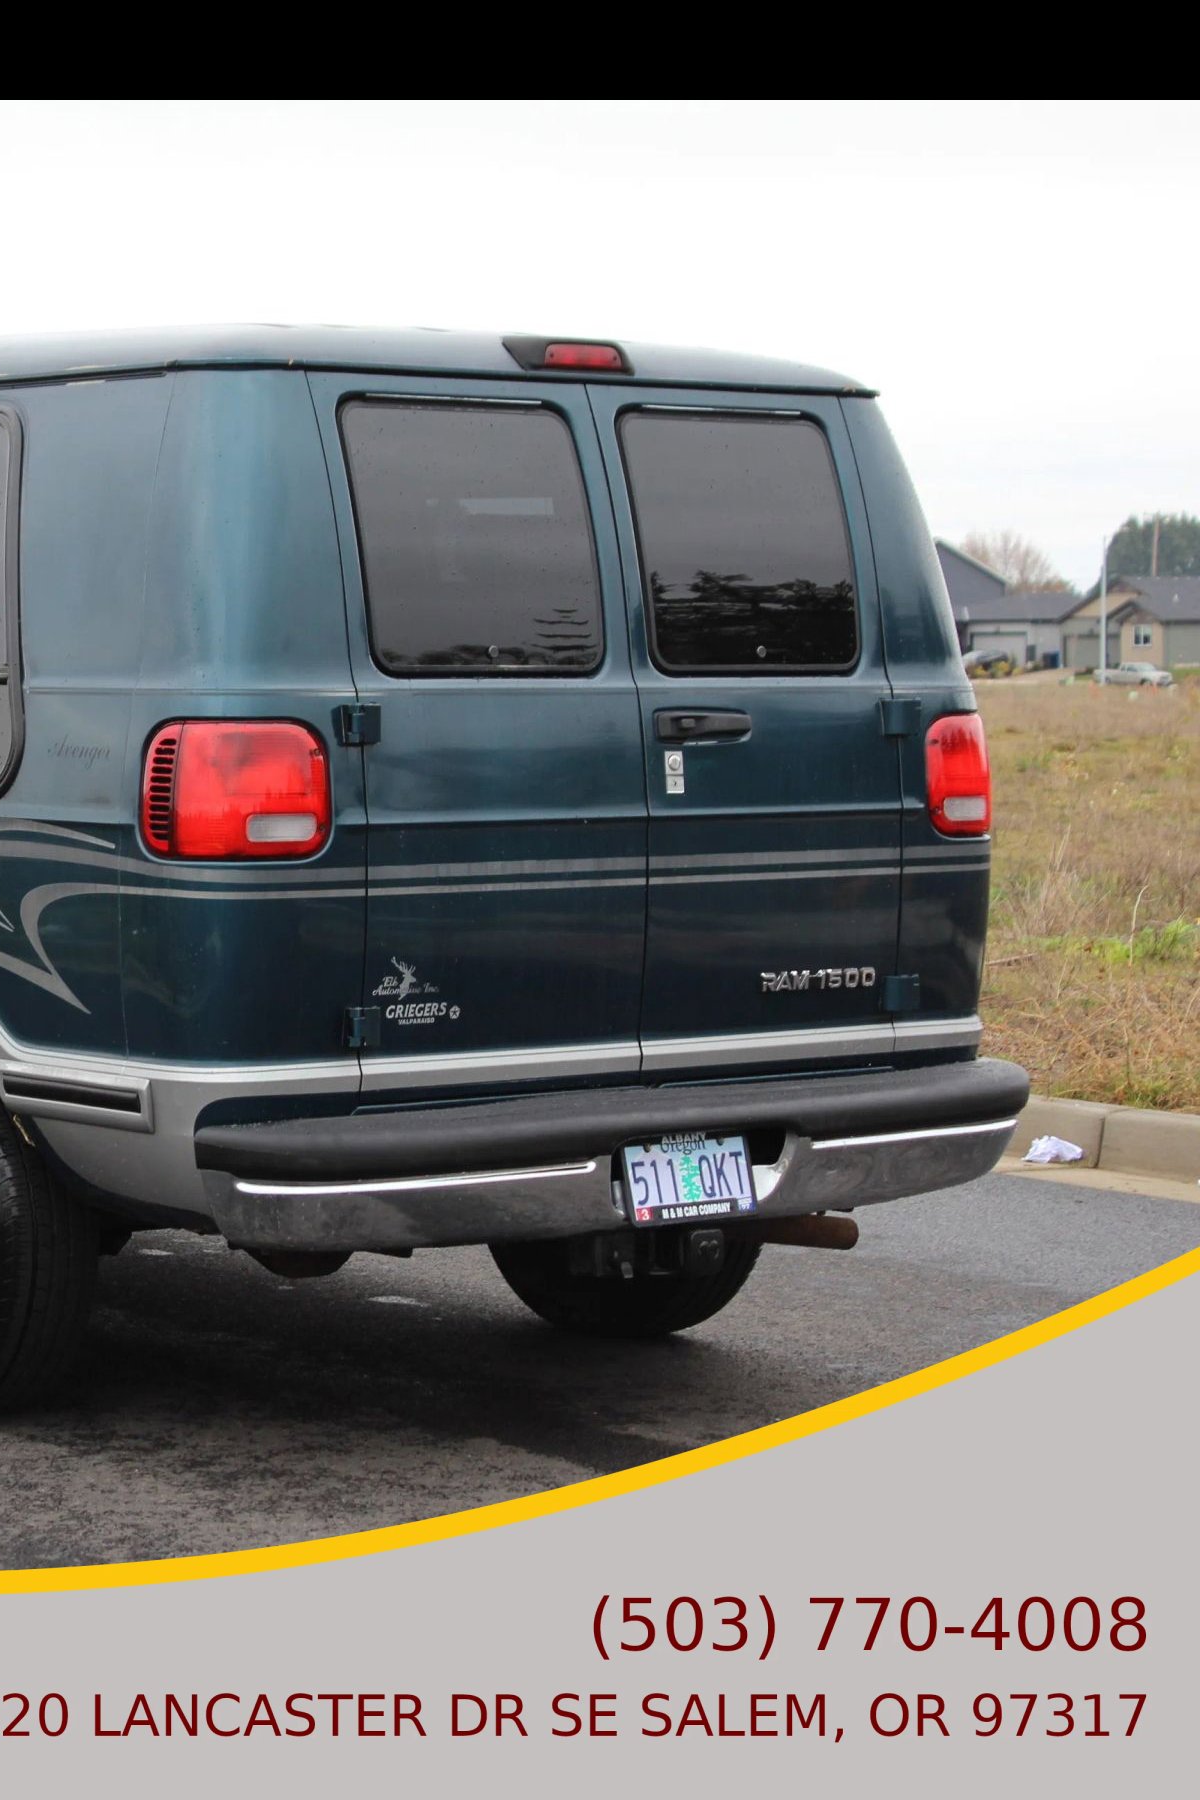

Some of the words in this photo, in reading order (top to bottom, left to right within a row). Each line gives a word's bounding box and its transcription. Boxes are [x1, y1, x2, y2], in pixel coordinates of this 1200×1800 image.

[372, 984, 421, 996] Automive
[385, 1002, 448, 1019] GRIEGERS
[398, 1017, 436, 1026] VALPARAISO
[661, 1131, 706, 1144] ALBANY
[660, 1139, 706, 1155] Oregon
[631, 1158, 680, 1206] 511
[698, 1151, 745, 1198] QKT
[662, 1208, 669, 1219] M
[670, 1207, 676, 1218] &
[684, 1205, 699, 1217] CAR
[699, 1202, 731, 1216] COMPANY
